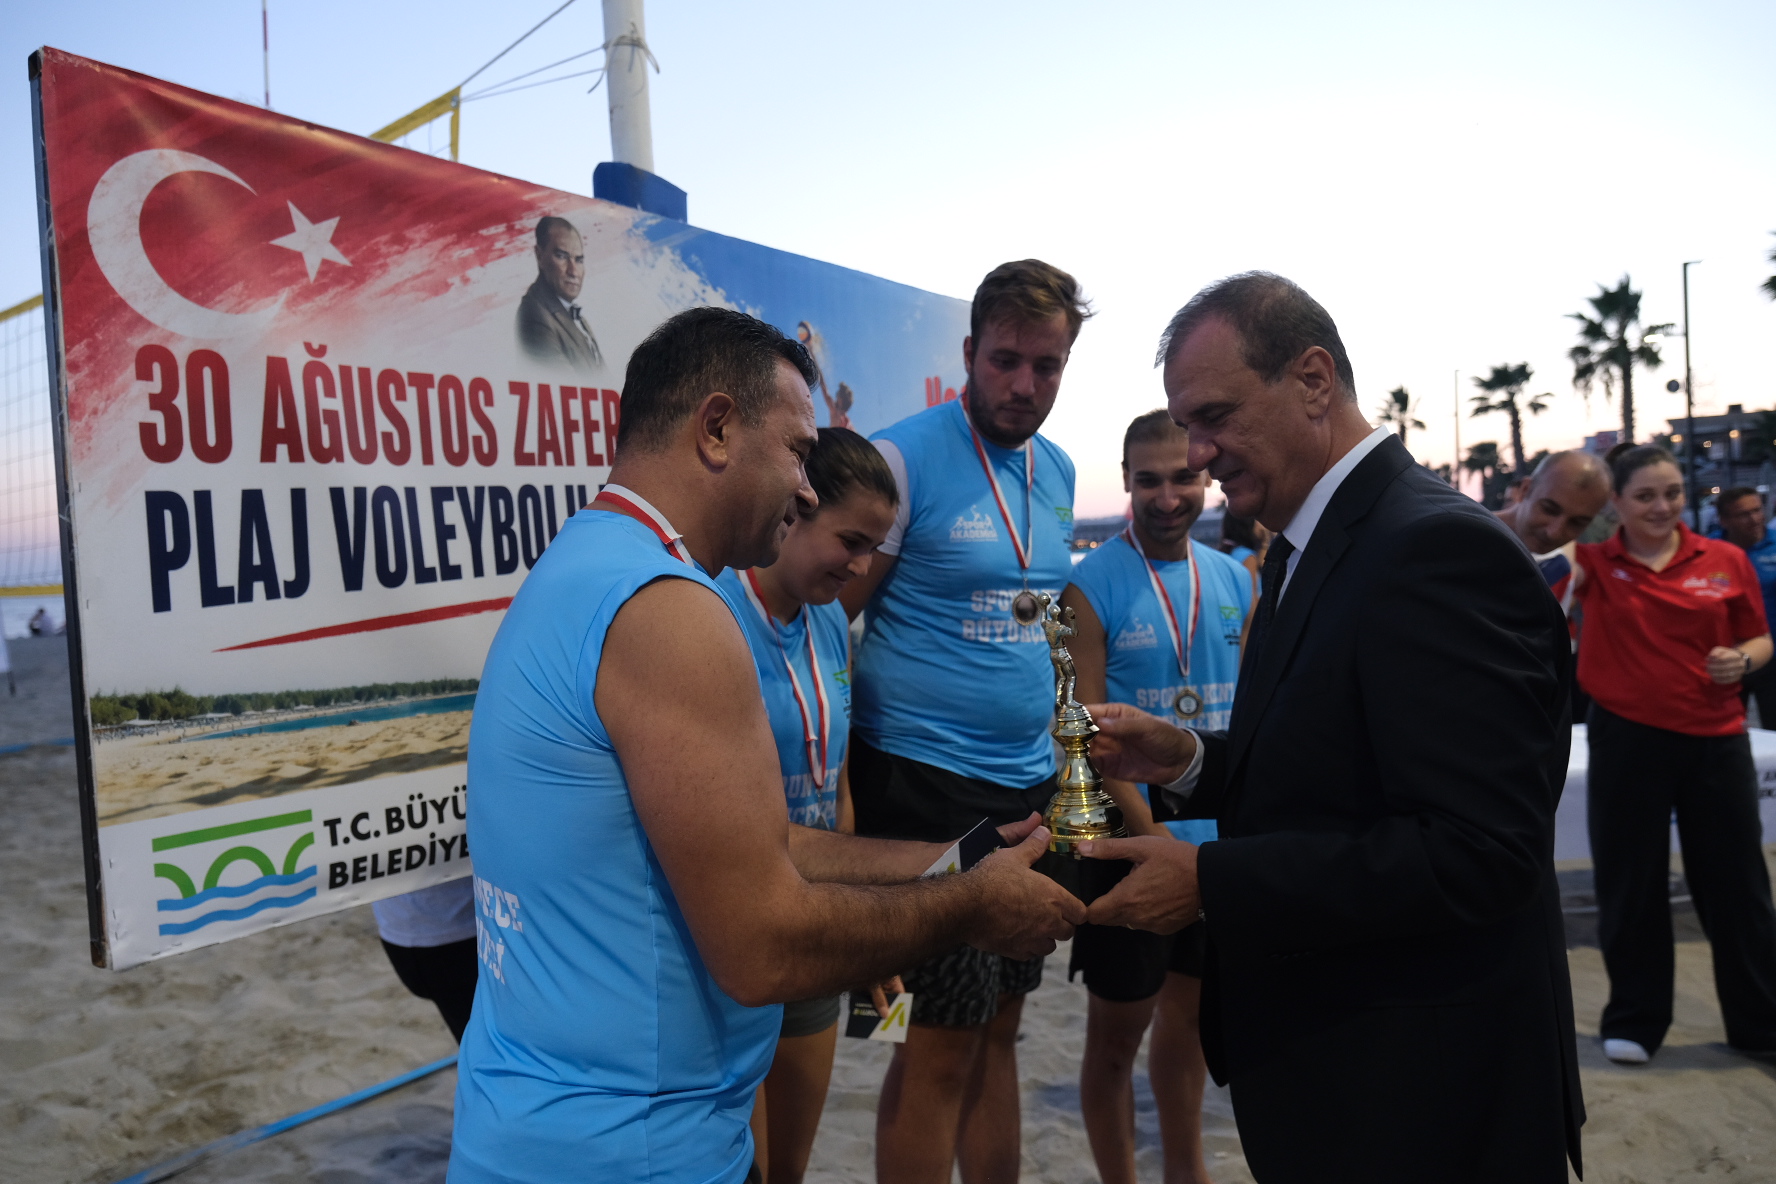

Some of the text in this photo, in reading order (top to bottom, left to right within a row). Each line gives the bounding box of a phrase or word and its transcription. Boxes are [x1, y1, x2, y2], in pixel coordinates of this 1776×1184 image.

[135, 341, 621, 467] 30 AĞUSTOS ZAFER
[144, 487, 310, 613] PLAJ
[323, 811, 381, 847] T.C.
